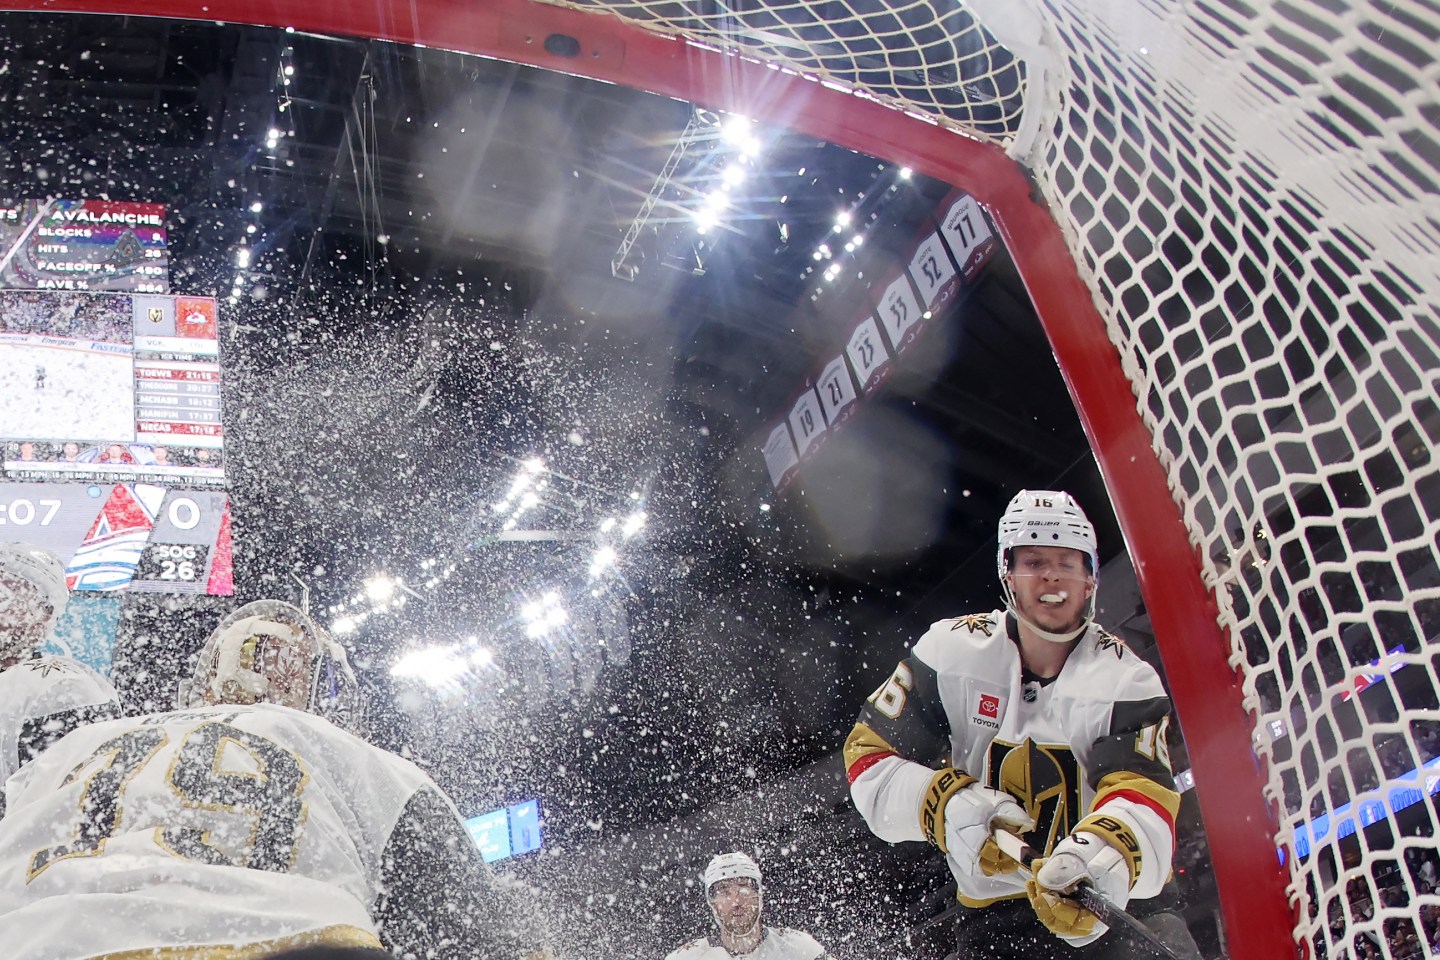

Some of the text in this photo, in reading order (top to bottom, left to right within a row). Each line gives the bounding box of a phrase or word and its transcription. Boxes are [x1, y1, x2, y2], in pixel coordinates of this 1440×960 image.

[51, 211, 160, 225] AVALANCHE
[38, 228, 92, 237] BLOCKS
[953, 213, 976, 249] 77
[37, 244, 161, 258] HITS 26
[37, 262, 163, 275] FACEOFF % .490
[921, 256, 942, 288] 52
[36, 279, 74, 289] SAVE
[77, 280, 88, 289] %
[889, 295, 907, 330] 33
[41, 336, 77, 347] Energizer
[858, 337, 874, 369] 23
[140, 369, 172, 378] TOEWS
[827, 376, 844, 407] 21
[140, 410, 179, 419] HANIFIN
[141, 423, 171, 432] NECAS
[799, 408, 815, 438] 19
[207, 477, 224, 485] MPH
[1034, 498, 1053, 508] 16
[168, 497, 201, 530] 0
[158, 544, 196, 559] SOG
[161, 561, 196, 580] 26
[972, 716, 1000, 730] TOYOTA
[1185, 773, 1193, 786] 3
[1090, 817, 1142, 889] BAU
